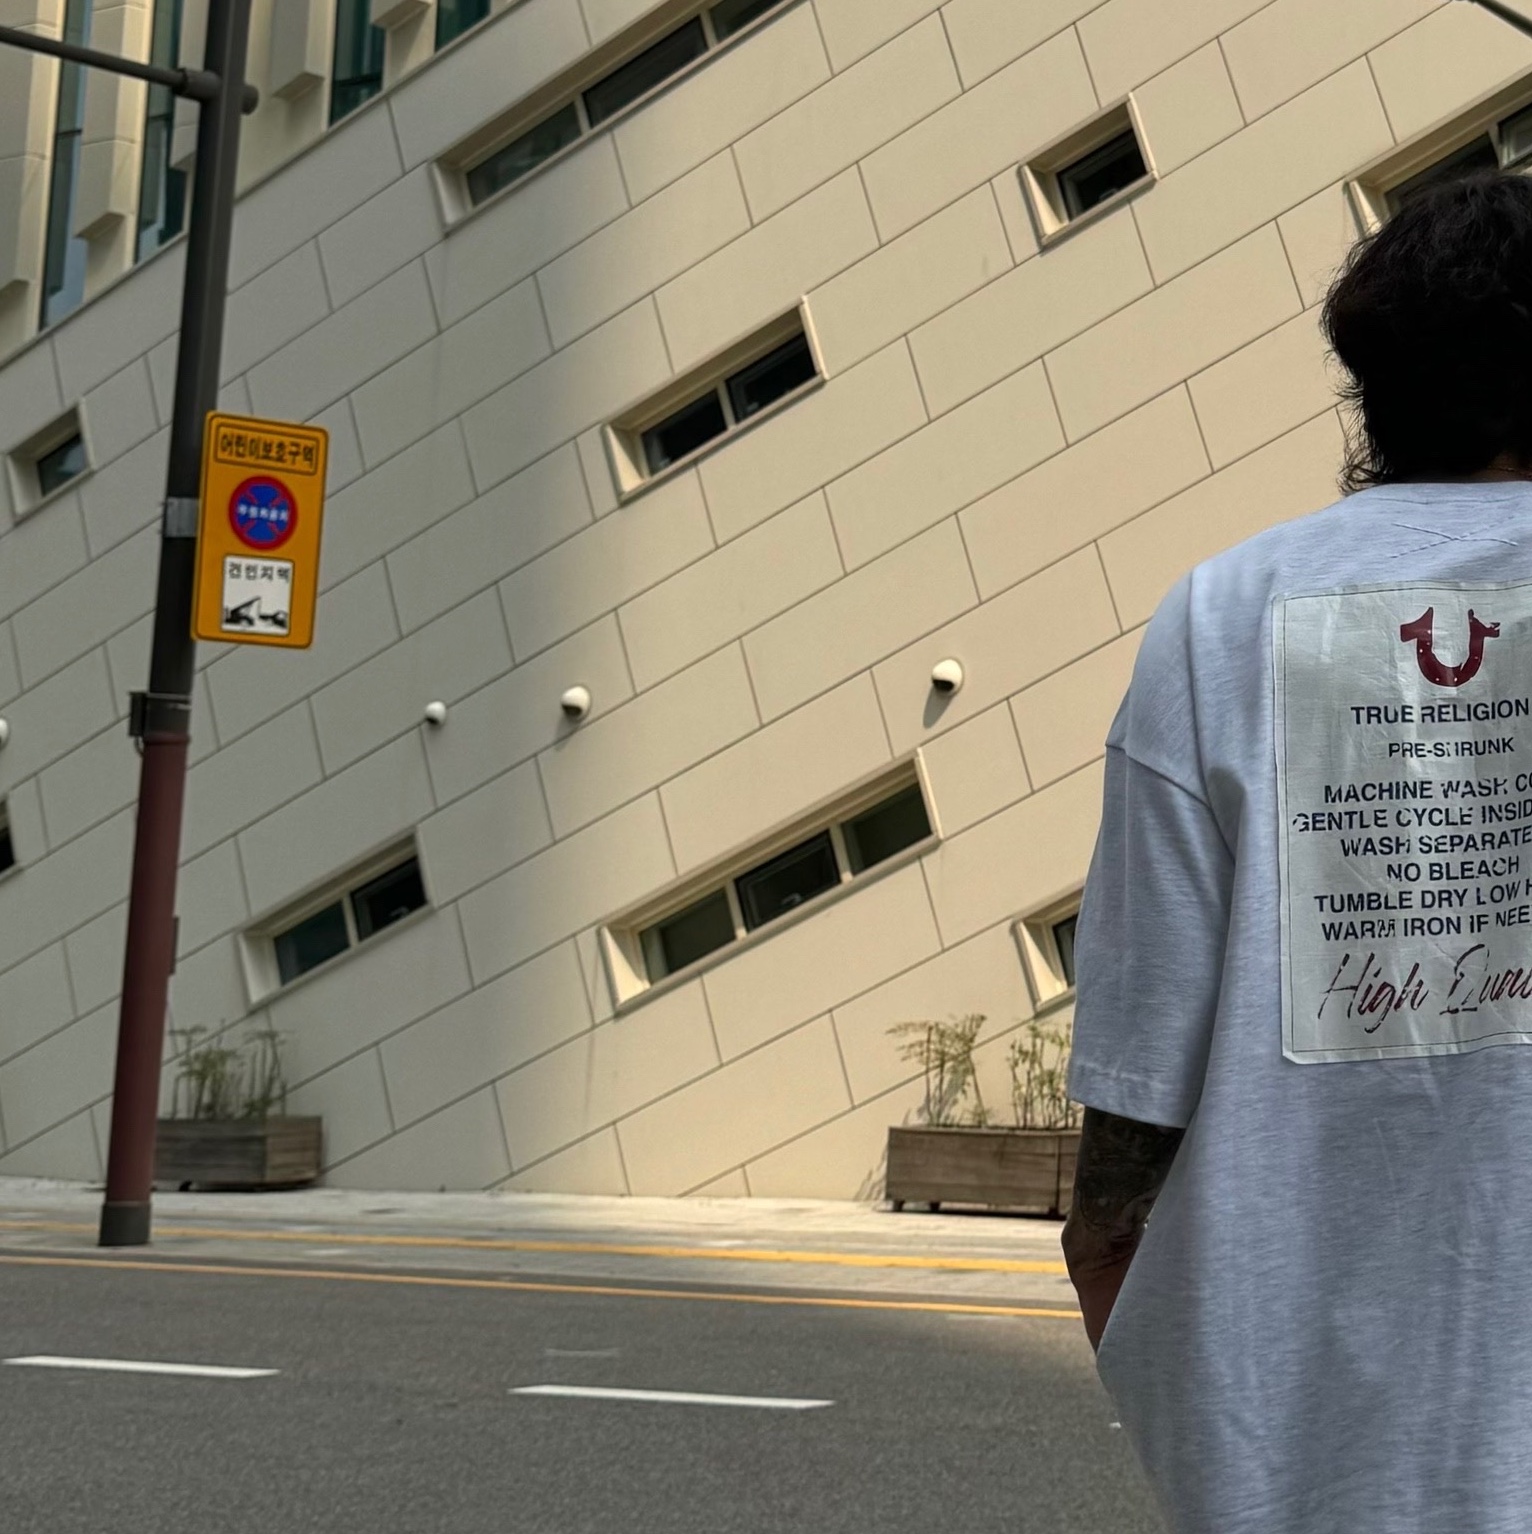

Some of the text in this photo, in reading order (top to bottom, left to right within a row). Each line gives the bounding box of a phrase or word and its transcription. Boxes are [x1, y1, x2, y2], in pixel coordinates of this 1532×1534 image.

[220, 433, 314, 470] 어린이보호구역
[229, 562, 291, 583] 견인지역
[1351, 705, 1414, 725] TRUE
[1421, 698, 1529, 723] RELIGION
[1324, 781, 1433, 803] MACHINE
[1441, 778, 1508, 799] WASH
[1293, 809, 1387, 832] GENTLE
[1396, 807, 1474, 828] CYCLE
[1341, 835, 1411, 857] WASH
[1387, 856, 1519, 883] NO BLEACH
[1314, 891, 1413, 913] TUMBLE
[1421, 888, 1468, 909] DRY
[1476, 880, 1521, 906] LOW
[1321, 919, 1396, 941] WARM
[1404, 916, 1461, 936] IRON
[1469, 914, 1489, 934] IF
[1317, 952, 1429, 1033] High
